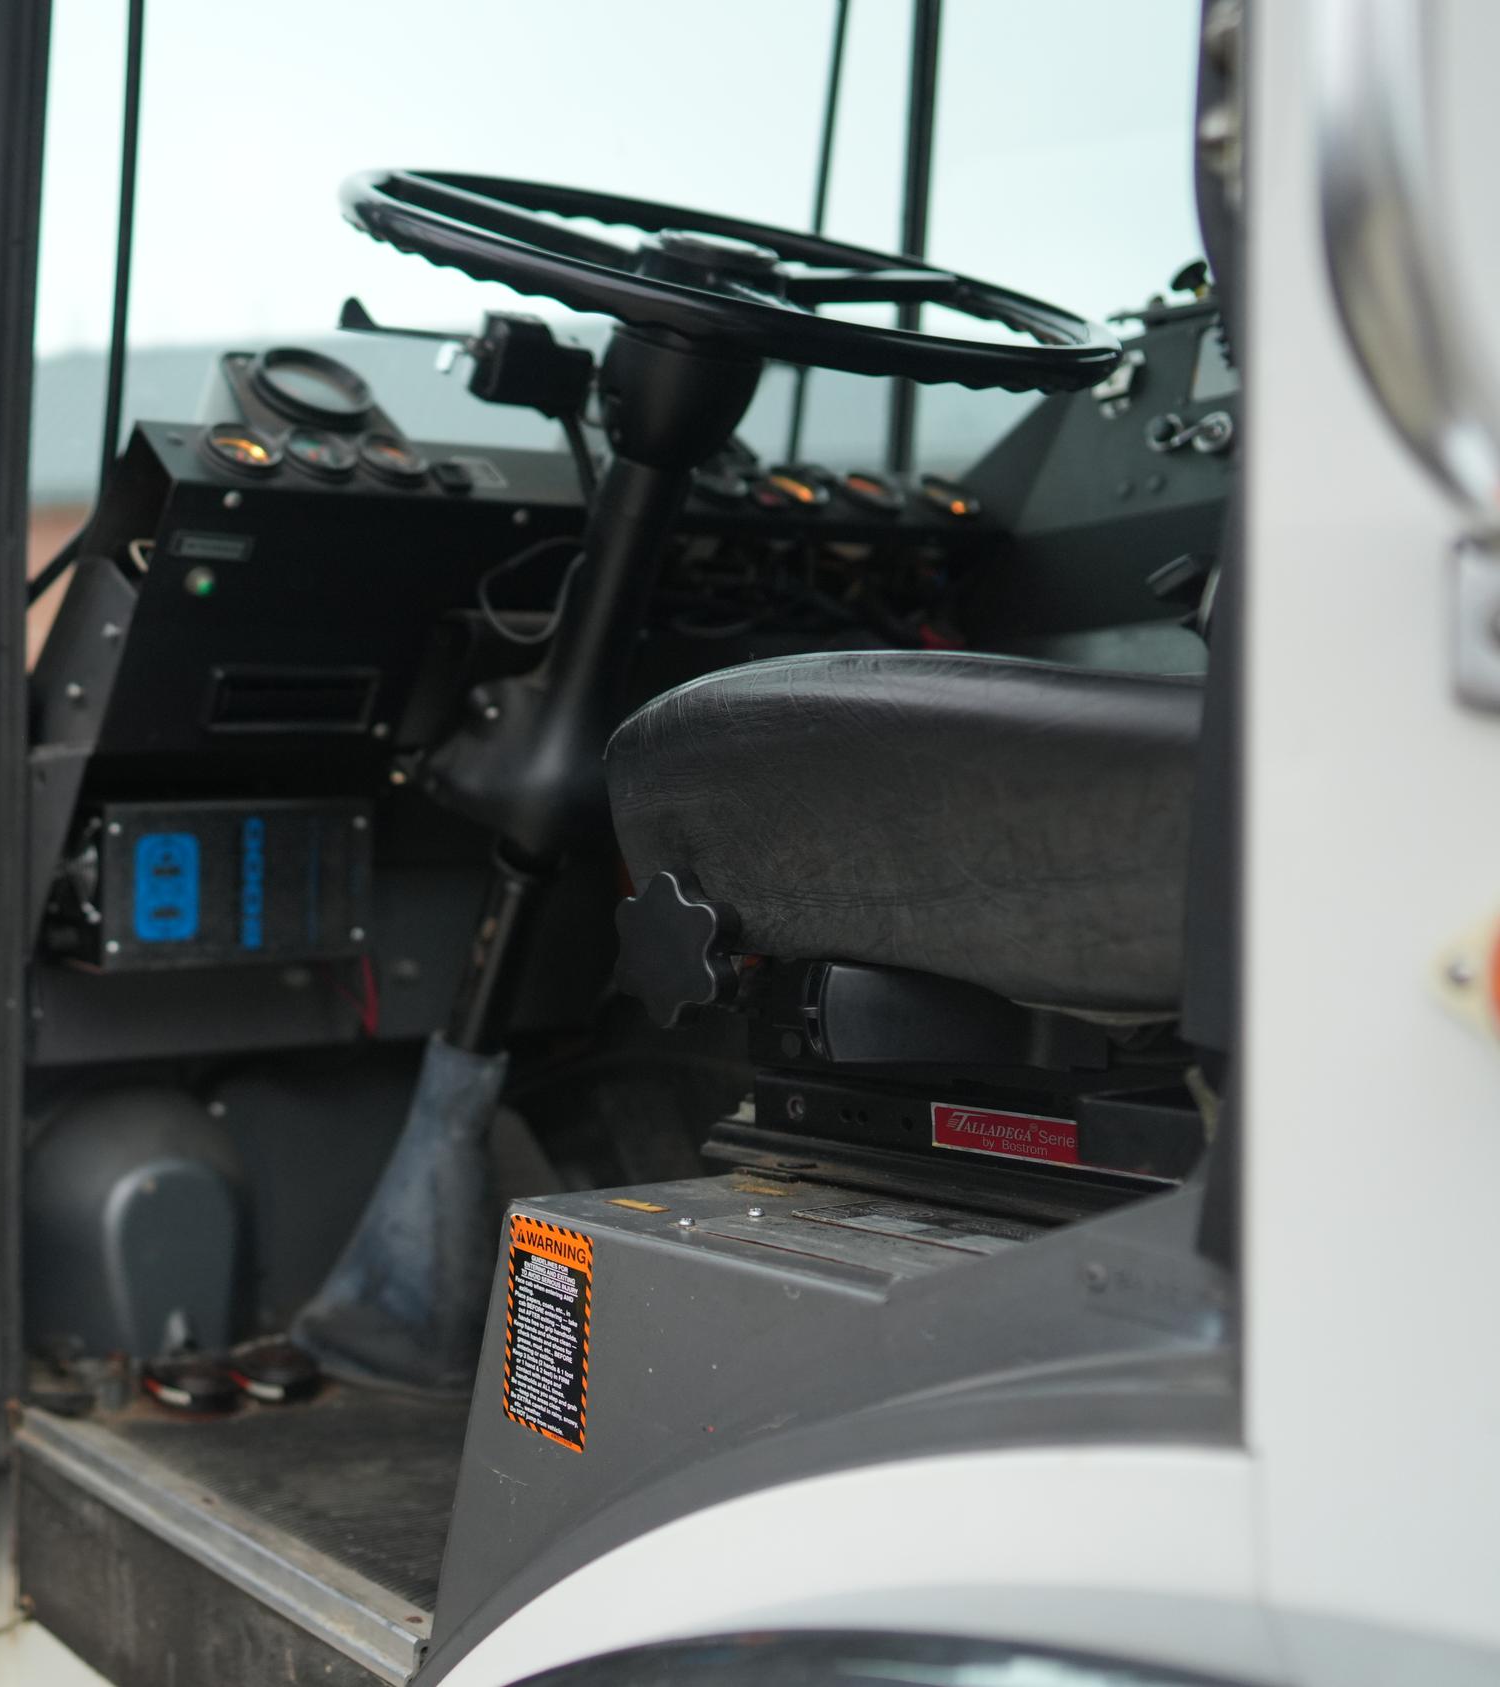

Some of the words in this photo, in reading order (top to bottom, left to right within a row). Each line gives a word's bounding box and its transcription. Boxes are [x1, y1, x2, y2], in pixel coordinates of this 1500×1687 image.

[947, 1112, 1032, 1142] TALLADEGA
[1038, 1129, 1077, 1148] Serie
[982, 1137, 996, 1150] by
[1002, 1140, 1048, 1156] Bostrom
[526, 1231, 586, 1264] WARNING
[524, 1261, 546, 1274] ENTERING
[547, 1269, 556, 1278] AND
[557, 1273, 575, 1285] EXITING
[531, 1254, 558, 1270] GUIDELINES
[559, 1265, 568, 1274] FOR
[515, 1276, 525, 1284] Face
[534, 1283, 545, 1292] when
[546, 1288, 563, 1300] entering
[564, 1294, 574, 1303] AND
[528, 1271, 540, 1281] AVOID
[542, 1276, 561, 1289] SERIOUS
[562, 1284, 578, 1295] INJURY
